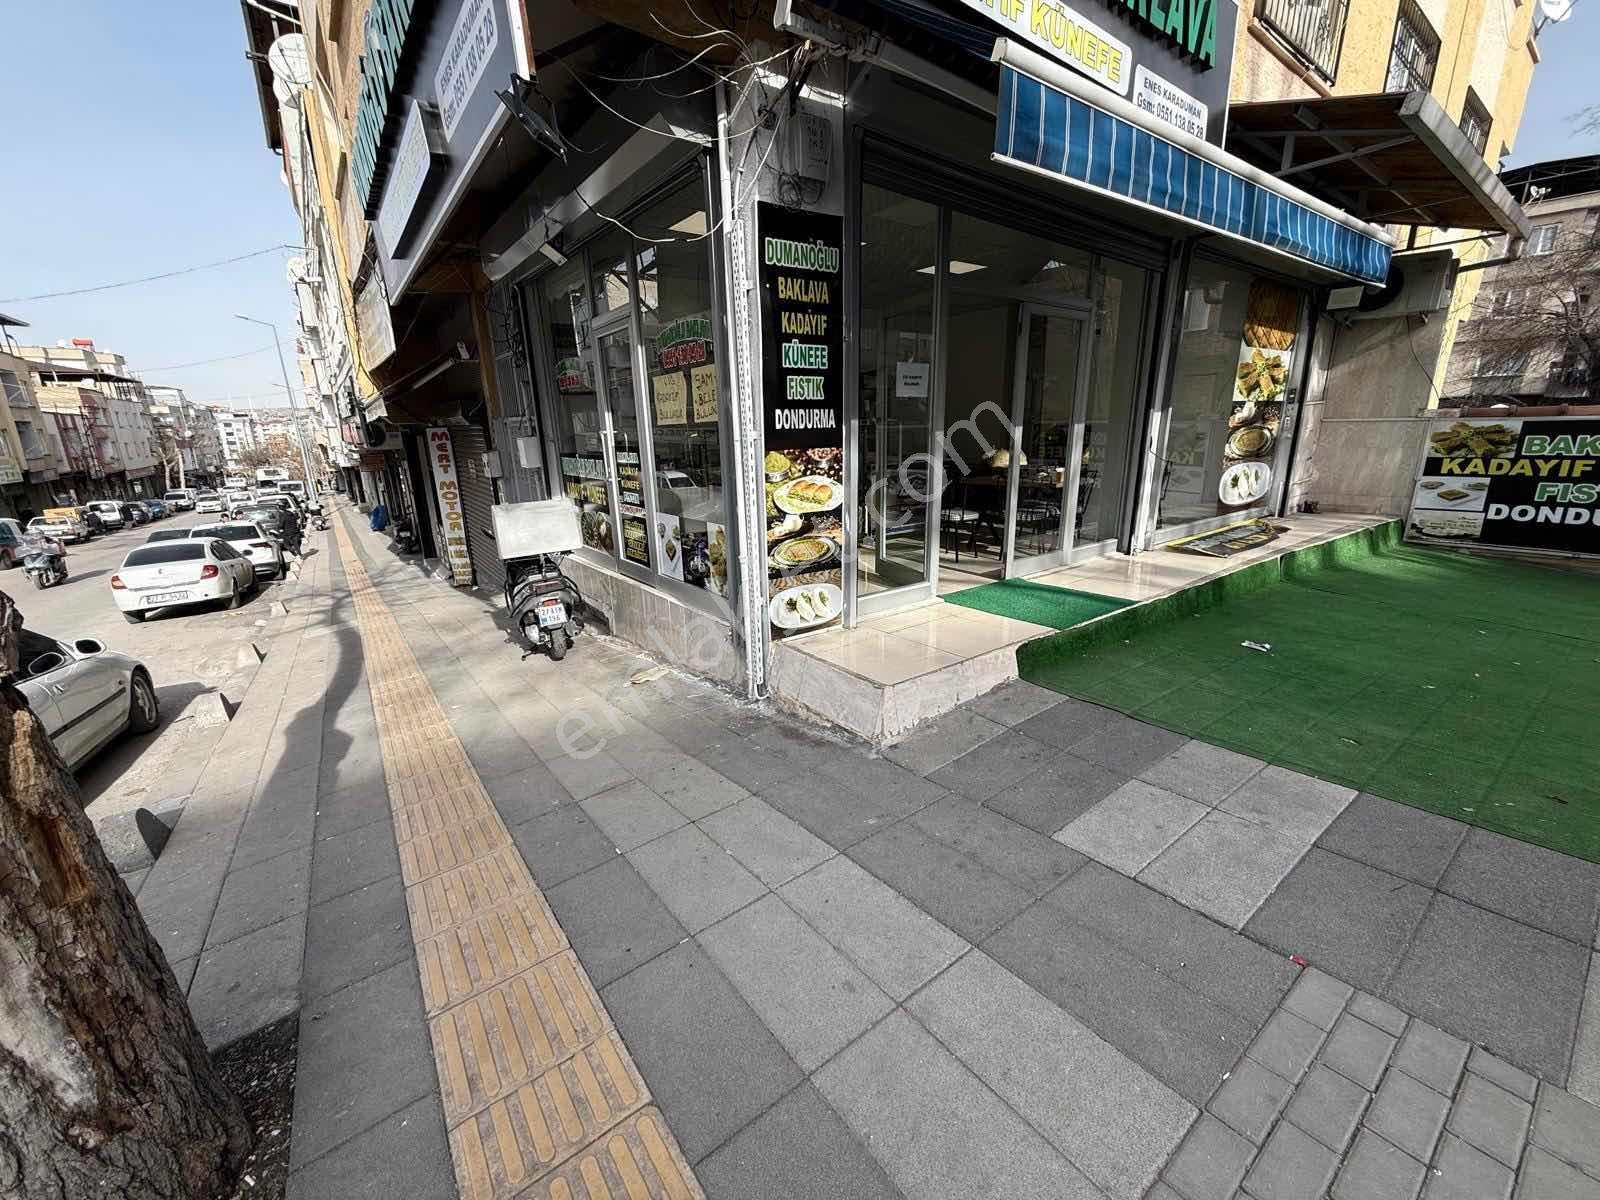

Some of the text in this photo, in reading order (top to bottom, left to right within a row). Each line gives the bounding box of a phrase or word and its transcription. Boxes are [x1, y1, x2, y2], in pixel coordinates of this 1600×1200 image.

[483, 8, 494, 47] 28
[1030, 2, 1123, 84] KÜNEFE
[1137, 92, 1156, 115] Gsm:
[1157, 102, 1173, 124] 0551
[1144, 76, 1201, 119] ENES KARADUMAN
[765, 237, 839, 273] DUMANOĞLU
[778, 276, 829, 304] BAKLAVA
[781, 311, 828, 336] KADAYIF
[782, 339, 828, 369] KÜNEFE
[787, 376, 825, 400] FISTIK
[775, 409, 836, 430] DONDURMA
[431, 431, 451, 474] MERT
[1522, 435, 1600, 456] BAK
[1440, 458, 1596, 477] KADAYIF
[439, 480, 463, 531] MOTOR
[1534, 482, 1600, 503] FIS
